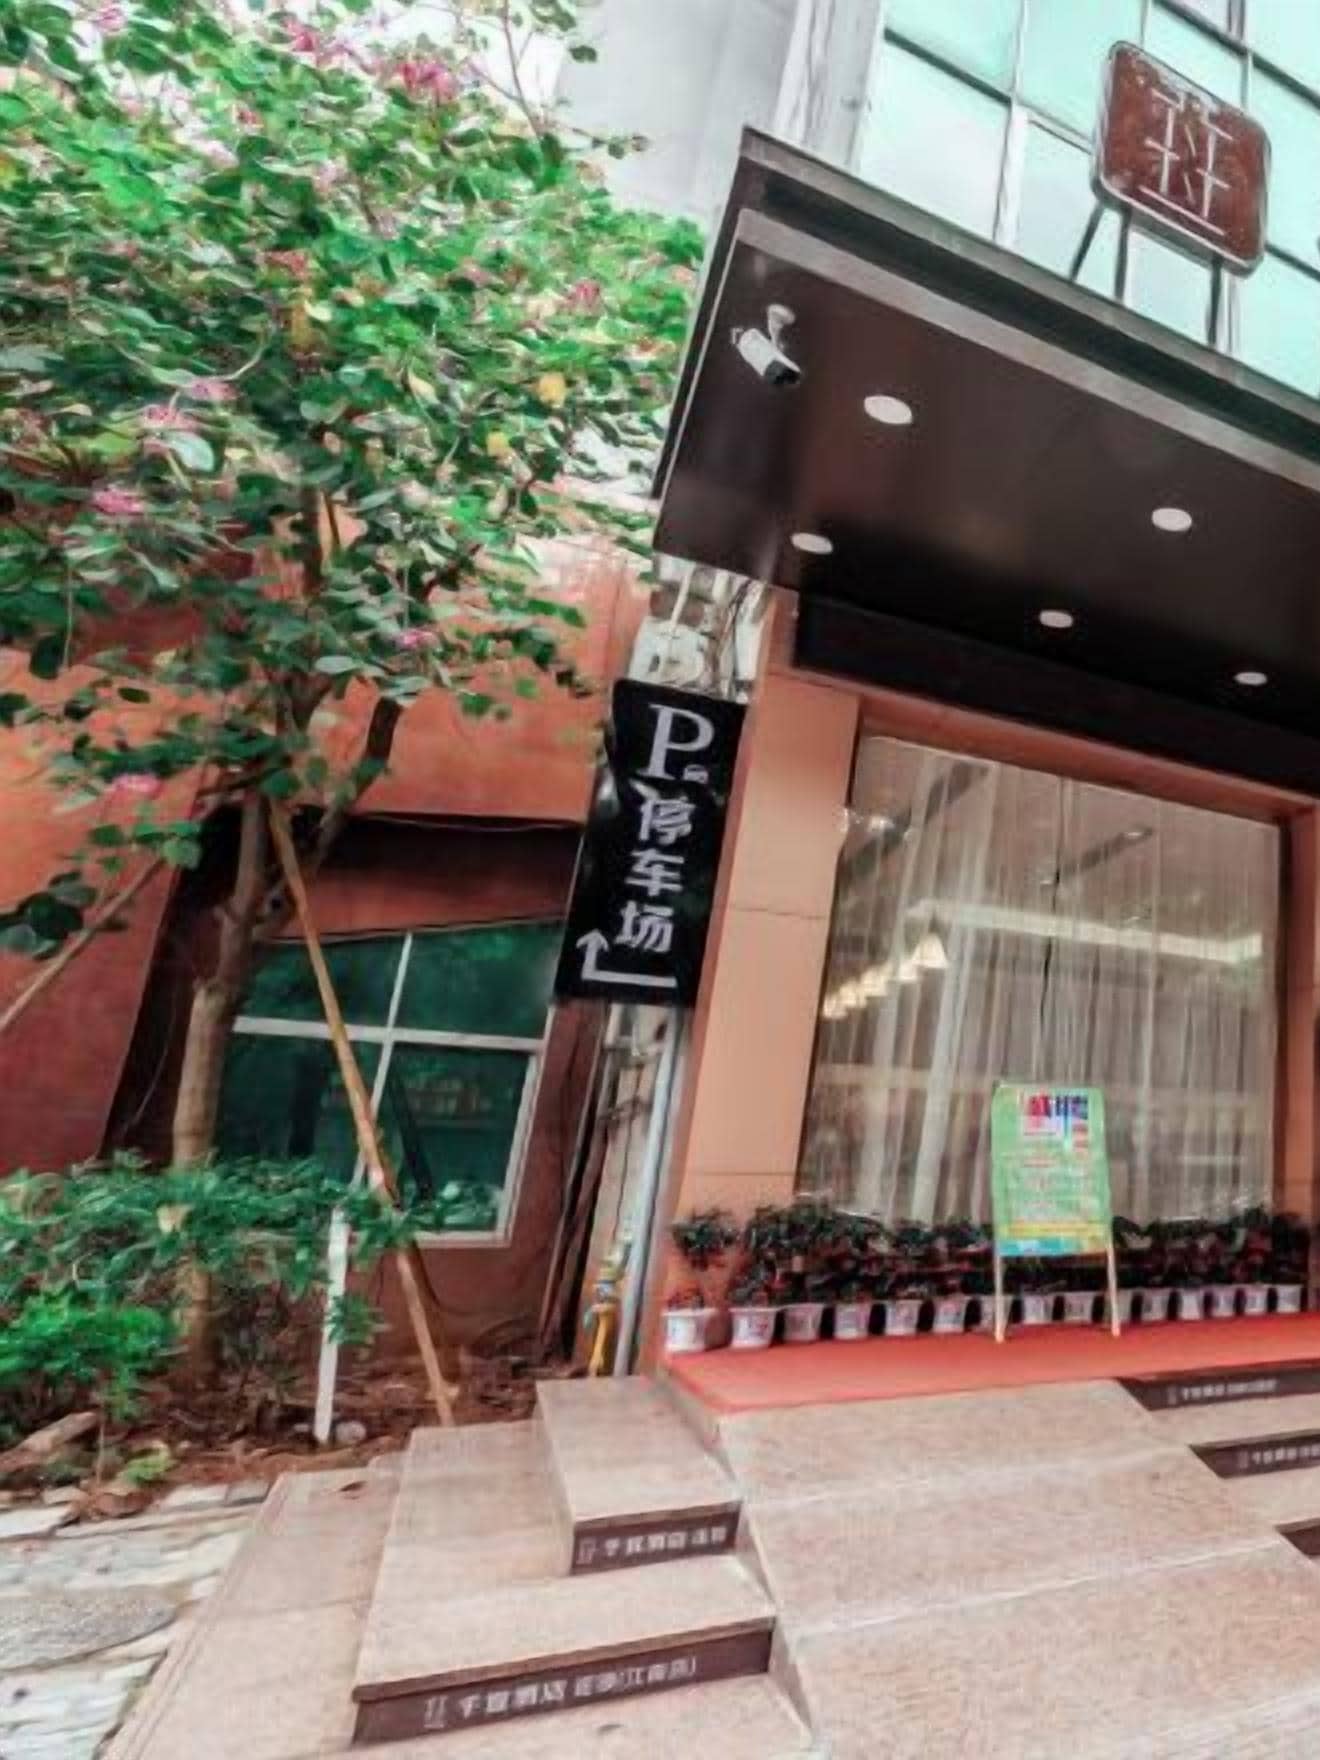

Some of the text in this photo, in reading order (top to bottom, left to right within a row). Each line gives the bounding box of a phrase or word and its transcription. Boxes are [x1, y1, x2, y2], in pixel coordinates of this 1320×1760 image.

[635, 704, 715, 781] P
[616, 786, 696, 954] 停车场
